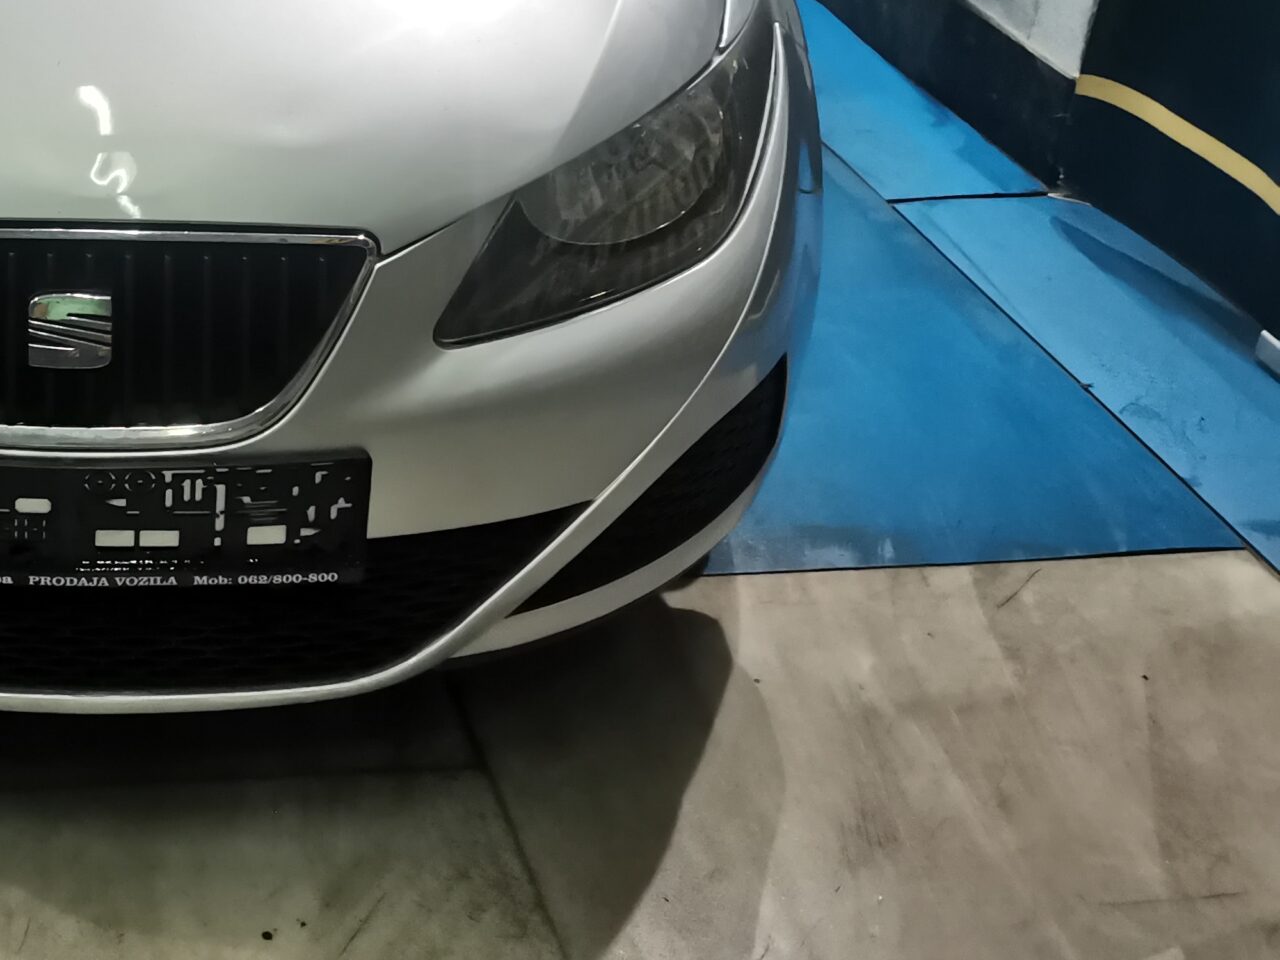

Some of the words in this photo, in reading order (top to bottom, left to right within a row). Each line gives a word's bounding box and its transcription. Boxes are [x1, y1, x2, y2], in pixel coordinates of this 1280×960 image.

[28, 575, 110, 587] PRODAJA
[115, 576, 178, 587] VOZILA
[193, 575, 232, 586] Mob:
[238, 572, 339, 585] 062/800-800
